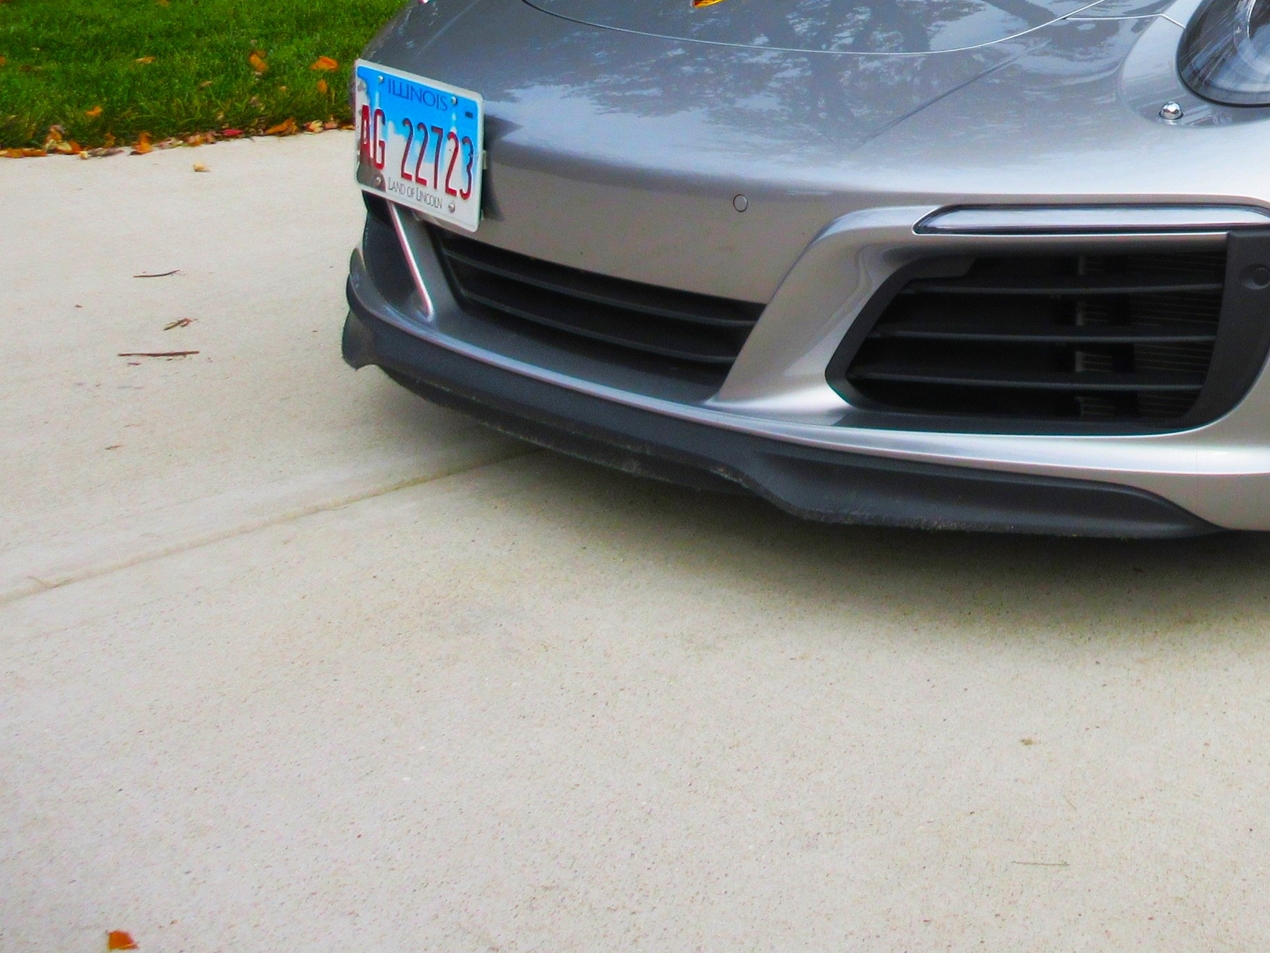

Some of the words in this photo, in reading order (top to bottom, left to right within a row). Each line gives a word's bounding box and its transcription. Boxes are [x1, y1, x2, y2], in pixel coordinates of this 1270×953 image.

[388, 79, 448, 112] ILLINOIS
[360, 105, 386, 170] AG
[401, 118, 474, 200] 22723
